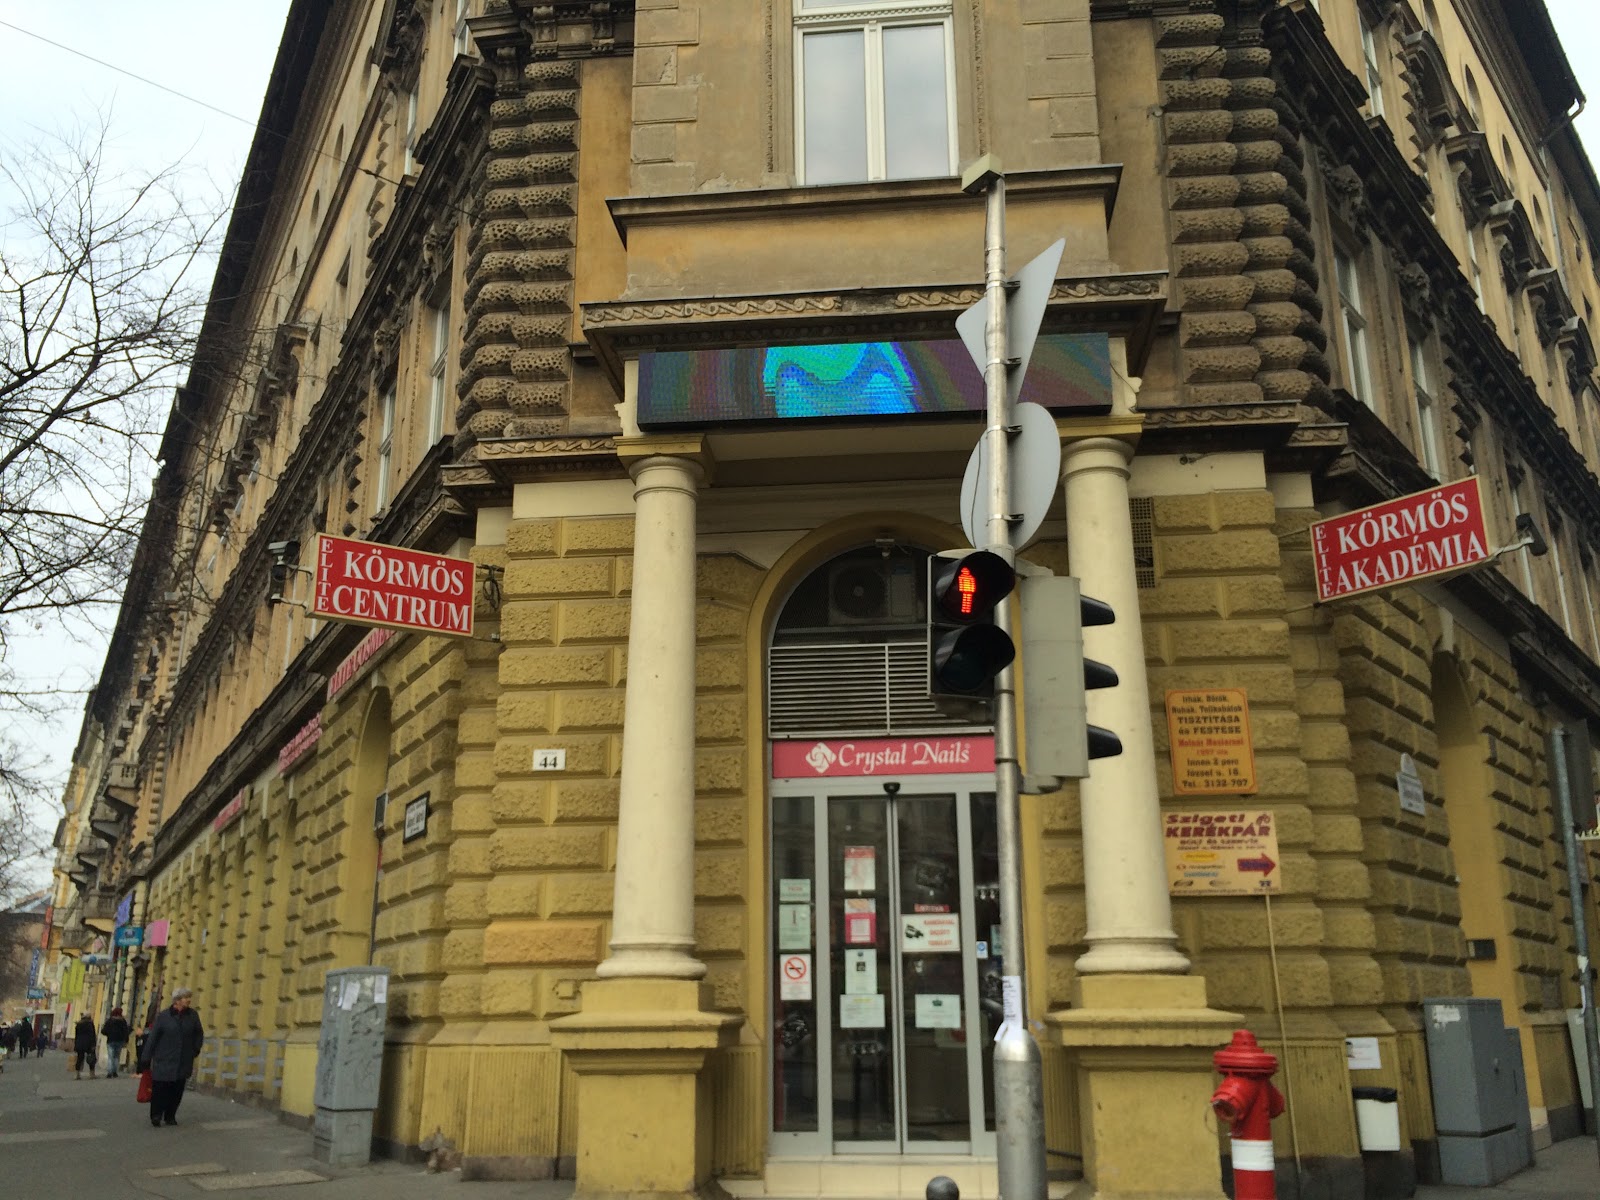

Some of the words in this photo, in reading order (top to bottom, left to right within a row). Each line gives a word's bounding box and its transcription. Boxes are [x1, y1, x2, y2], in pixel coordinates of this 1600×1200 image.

[1336, 491, 1469, 555] KÖRMÖS
[317, 538, 334, 612] ELITE
[343, 548, 464, 596] KÖRMÖS
[1315, 525, 1335, 598] ELITE
[1336, 531, 1487, 594] AKADÉMIA
[332, 585, 471, 632] CENTRUM
[539, 756, 558, 768] 44
[838, 743, 906, 774] Crystal
[912, 742, 970, 766] Nails
[1165, 822, 1271, 838] KERÉKPÁR
[1166, 814, 1246, 826] Szigeti
